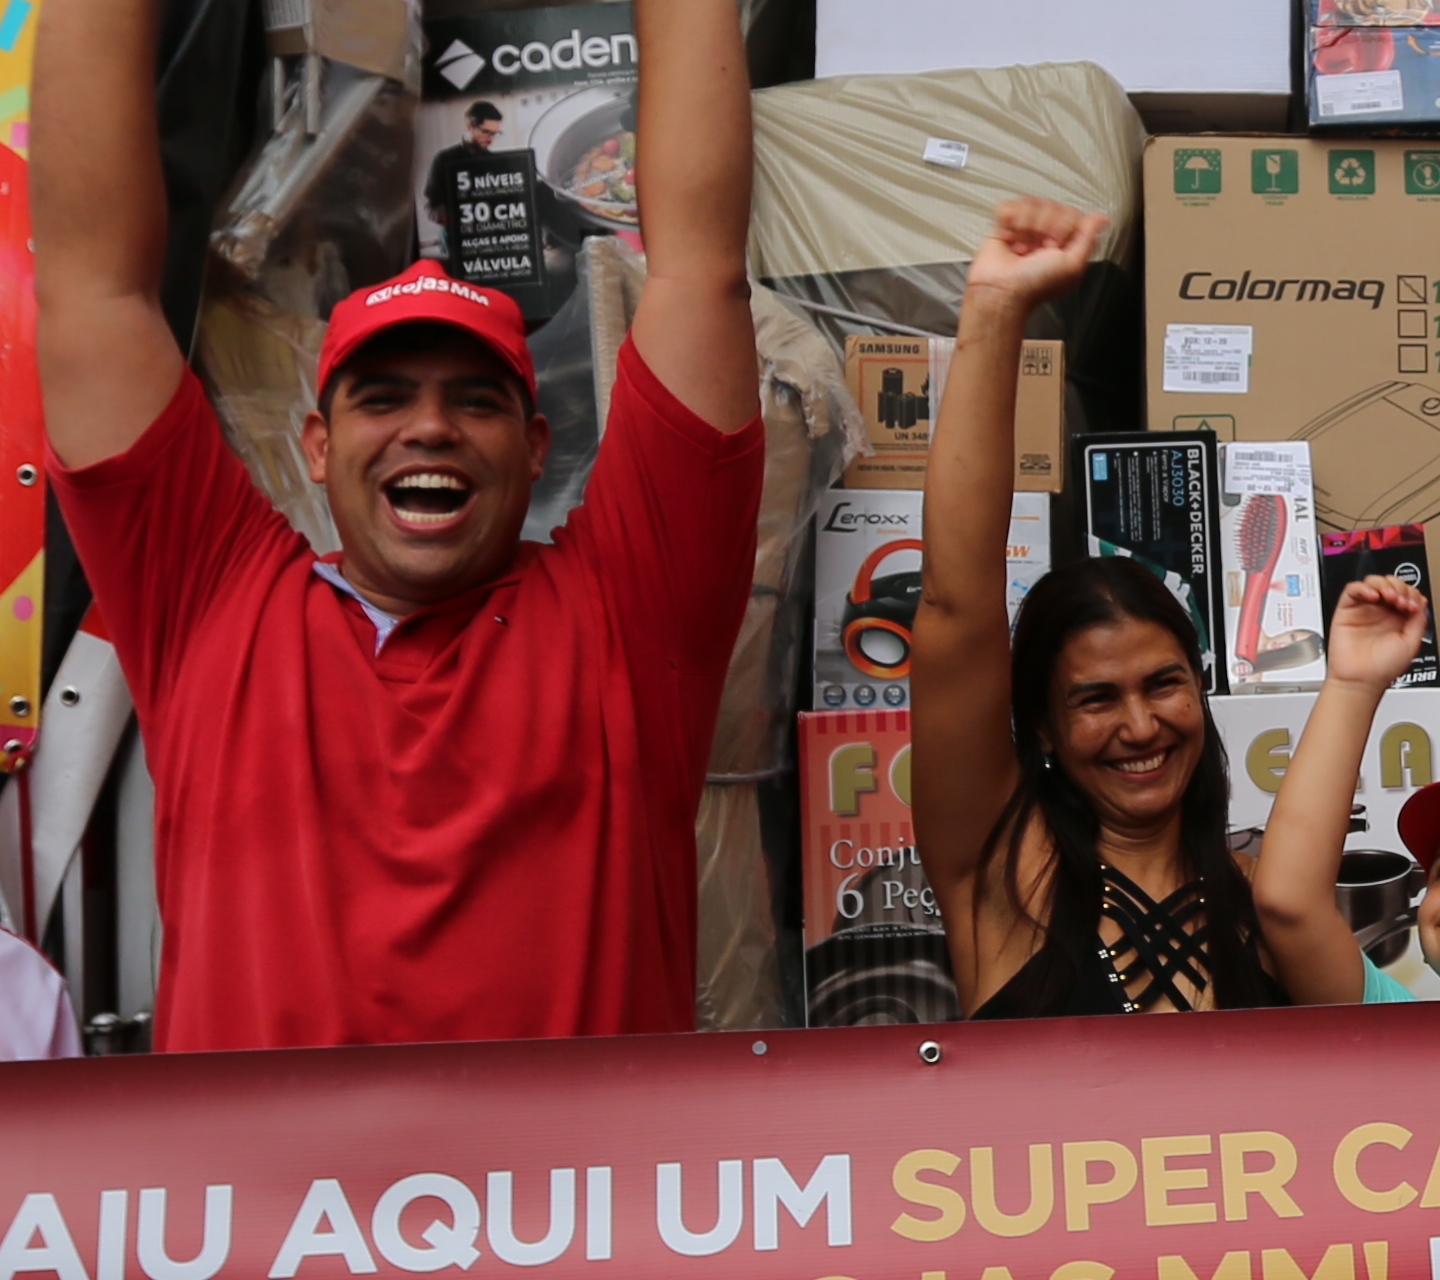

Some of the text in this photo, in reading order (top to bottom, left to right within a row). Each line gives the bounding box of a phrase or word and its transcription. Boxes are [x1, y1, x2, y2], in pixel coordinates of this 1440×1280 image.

[491, 28, 637, 76] caden
[457, 171, 525, 191] 5 NÍVEIS
[459, 202, 526, 224] 30 CM
[463, 255, 532, 274] VÁLVULA
[1178, 269, 1386, 310] Colormaq
[858, 342, 920, 355] SAMSUNG
[894, 431, 909, 441] UN
[1170, 449, 1185, 507] AJ3030
[821, 501, 910, 533] Lenoxx
[1186, 448, 1204, 574] BLACK+DECKER
[829, 836, 923, 872] Conju
[835, 872, 942, 920] 6 Peç
[267, 1165, 612, 1280] AQUI
[655, 1153, 852, 1257] UM
[889, 1128, 1304, 1243] SUPER
